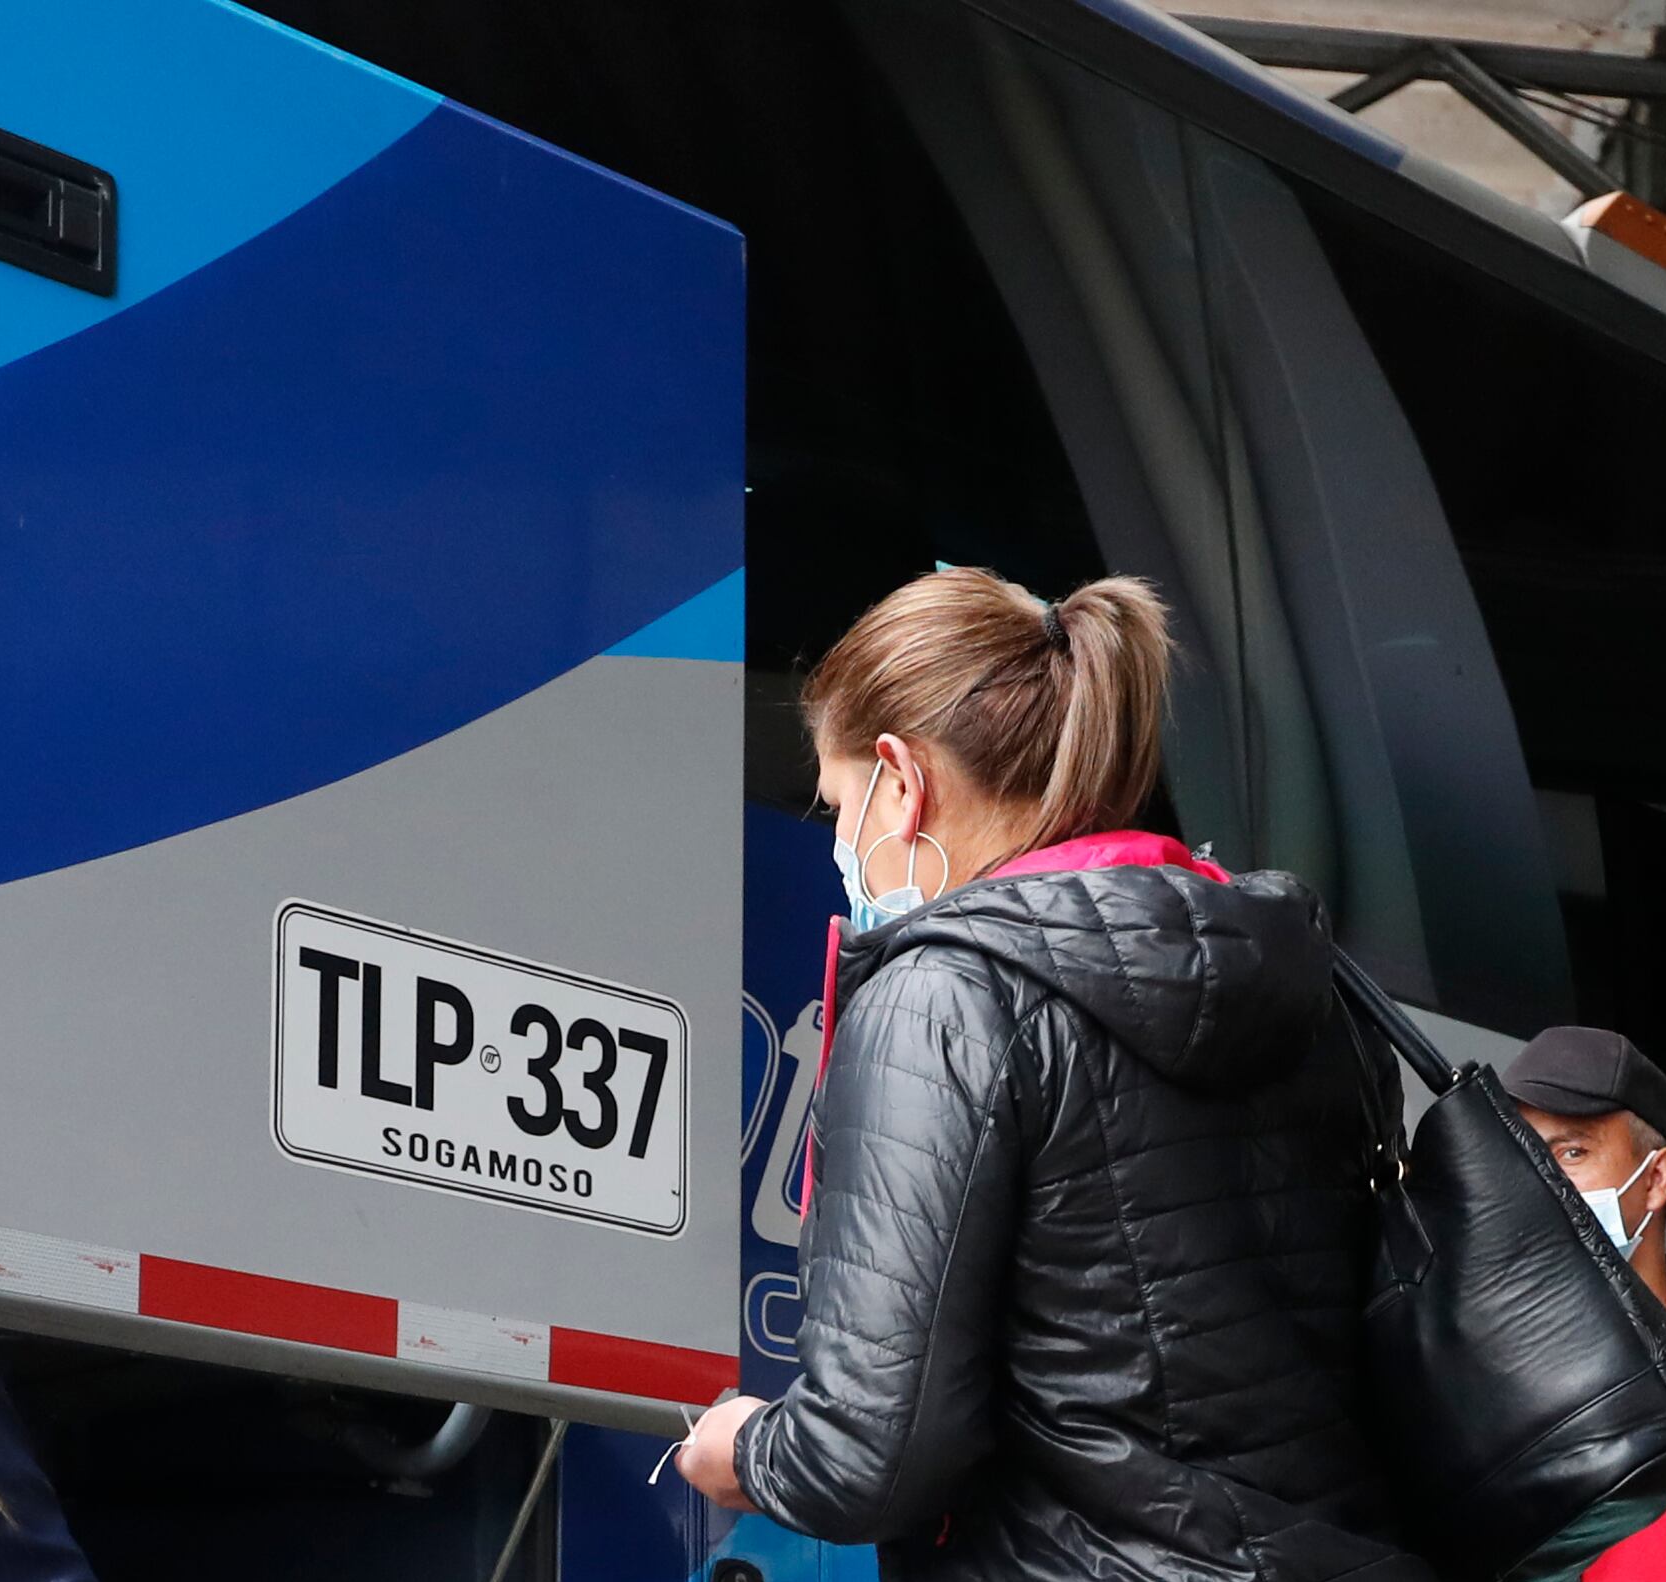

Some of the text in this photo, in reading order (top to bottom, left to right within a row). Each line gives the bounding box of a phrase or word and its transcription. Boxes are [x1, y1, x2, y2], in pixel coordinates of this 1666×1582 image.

[299, 946, 475, 1112] TLP
[506, 1003, 670, 1160] 337
[381, 1126, 594, 1199] SOGAMOSO
